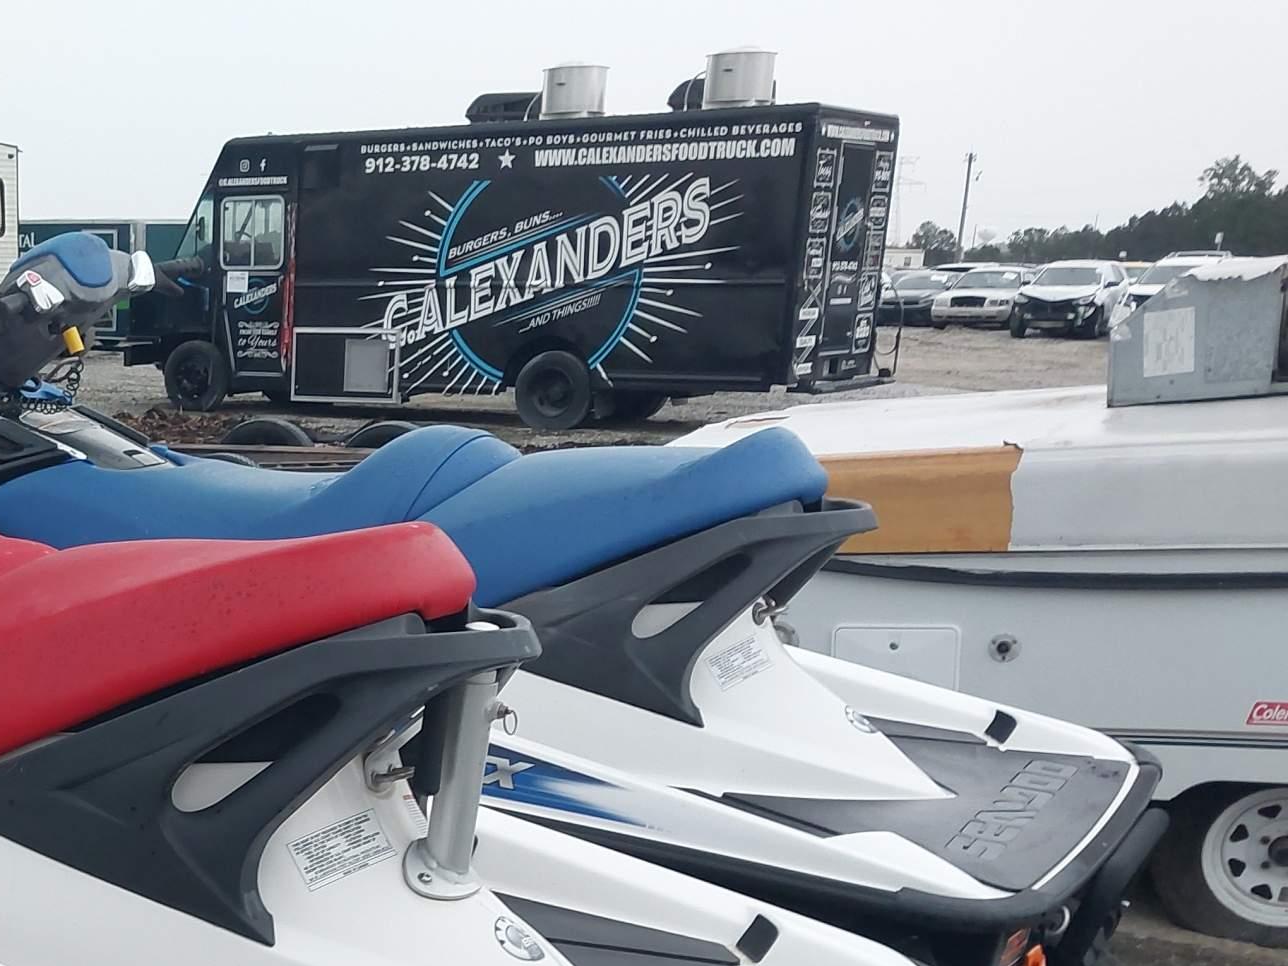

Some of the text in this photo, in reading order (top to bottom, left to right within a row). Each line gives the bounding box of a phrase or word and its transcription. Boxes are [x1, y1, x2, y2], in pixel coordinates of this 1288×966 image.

[361, 122, 803, 154] BURGERS SANDWICHES TACO'S PO BOYS GOURMET FRIES CHILLED BEVERAGES
[534, 138, 796, 167] WWW.CALEXANDERSFOODTRUCK.COM
[364, 153, 480, 174] 912-378-4742
